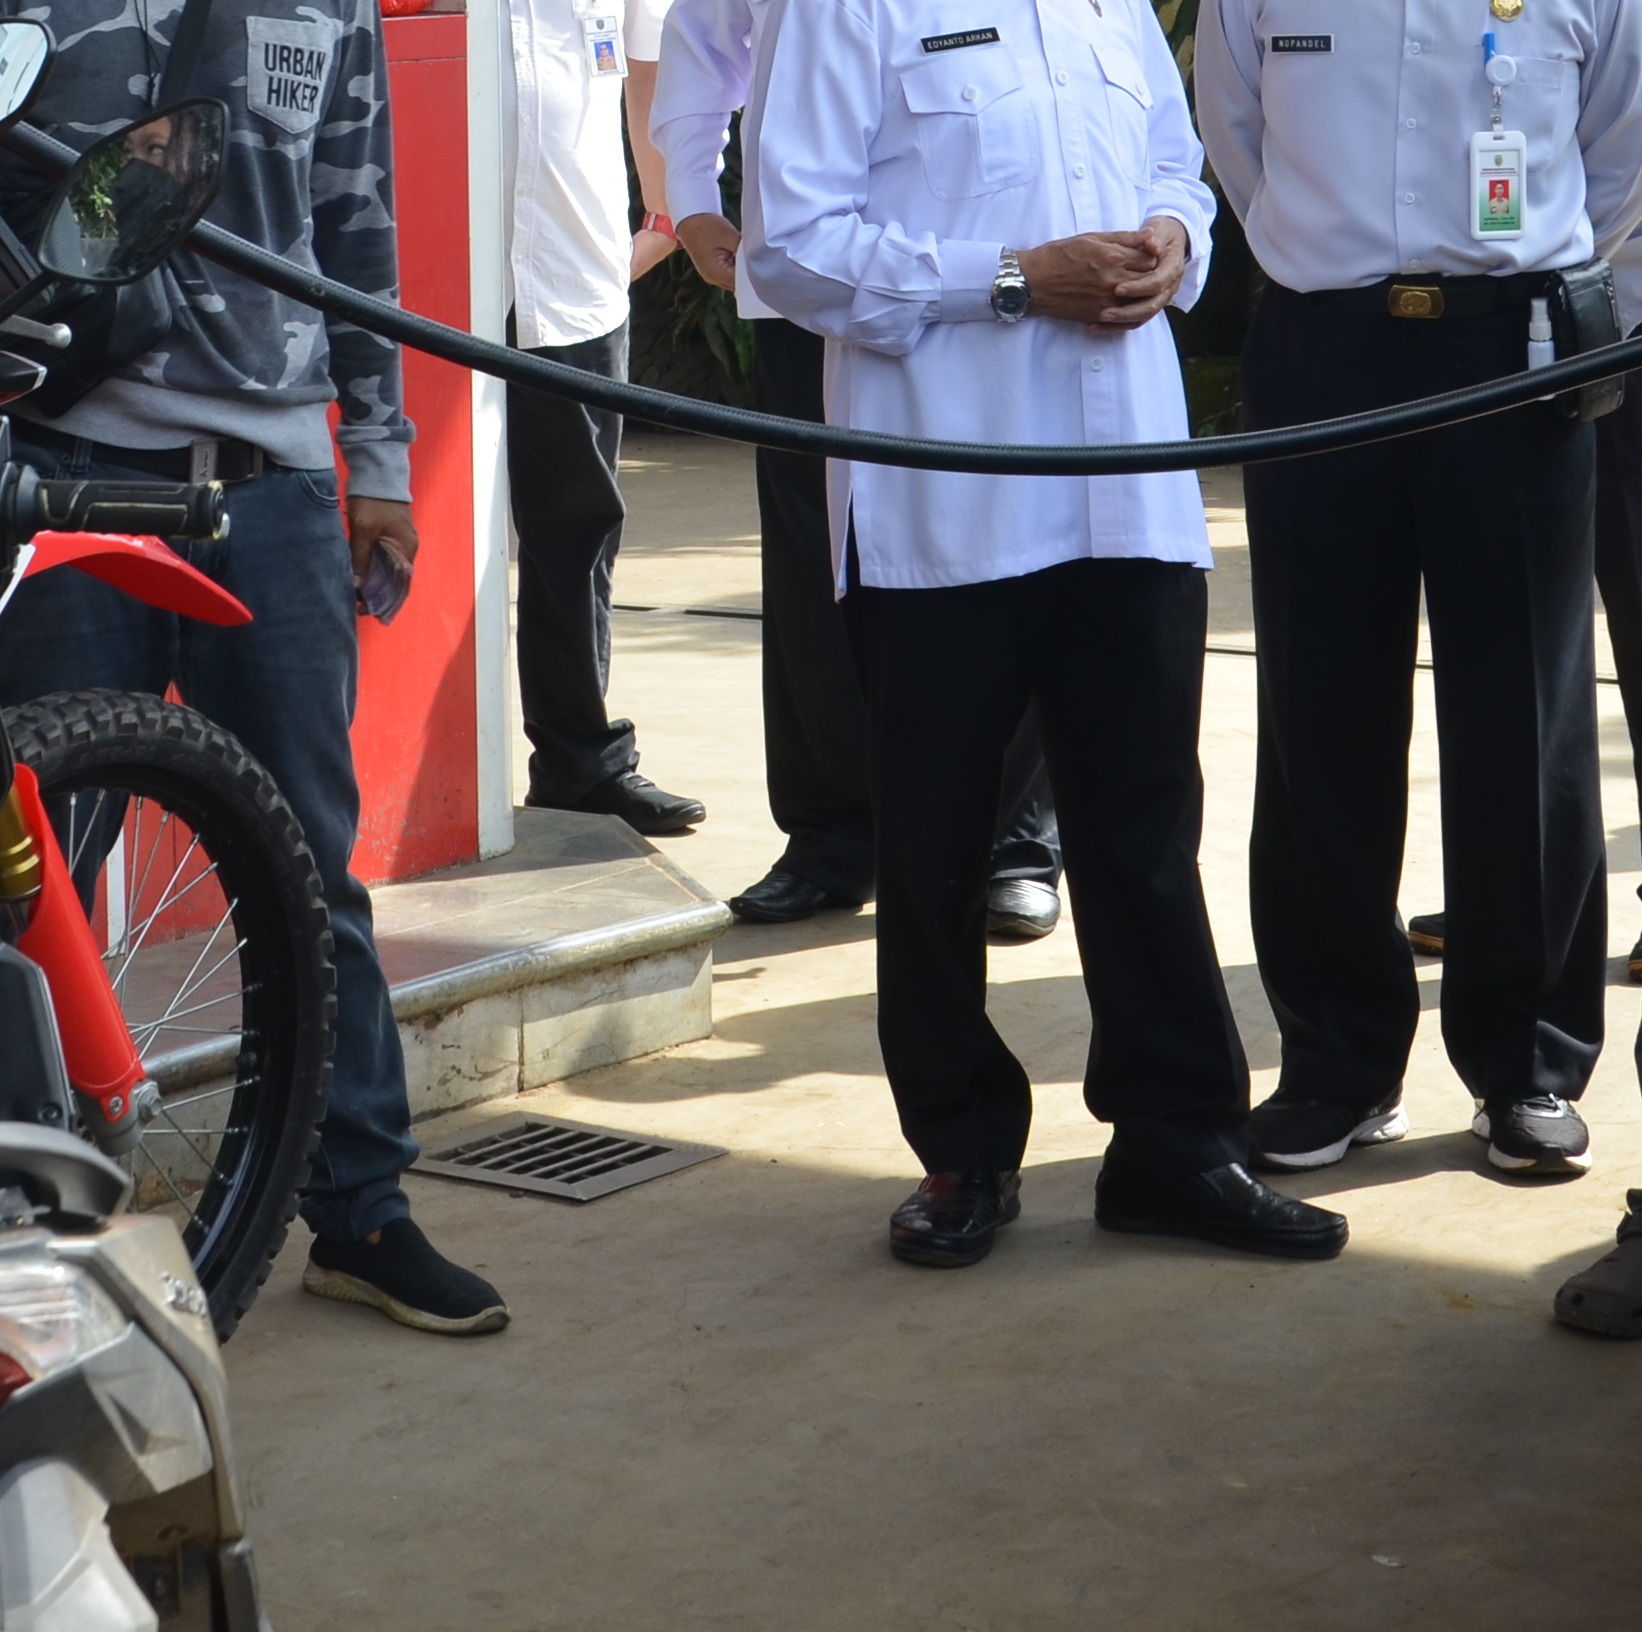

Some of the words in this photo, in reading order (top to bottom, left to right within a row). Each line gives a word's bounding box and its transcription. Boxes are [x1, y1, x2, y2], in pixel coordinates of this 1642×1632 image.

[927, 36, 964, 49] EDYANTO
[966, 32, 993, 43] ARKAN
[1278, 39, 1325, 48] NOPANDEL
[264, 42, 327, 82] URBAN
[267, 76, 319, 114] HIKER
